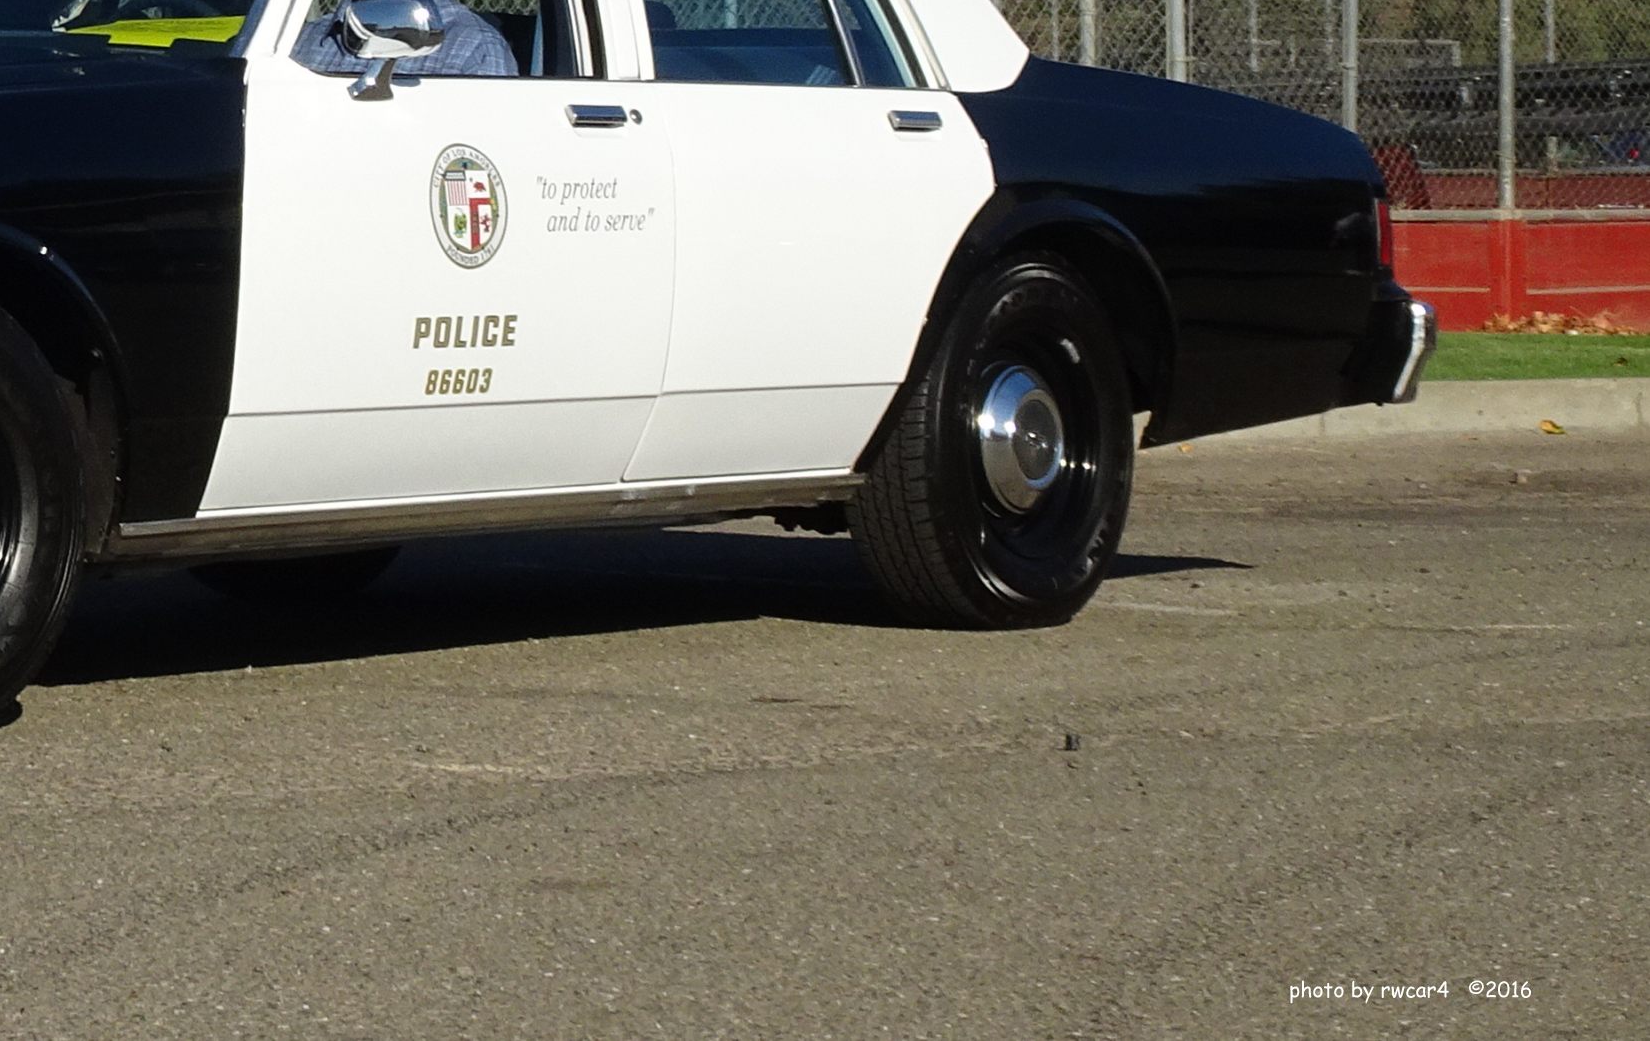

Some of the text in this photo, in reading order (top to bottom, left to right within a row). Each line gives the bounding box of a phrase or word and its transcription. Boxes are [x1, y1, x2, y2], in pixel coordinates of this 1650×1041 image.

[433, 164, 445, 188] CITY
[443, 153, 451, 164] OF
[451, 148, 467, 158] LOS
[561, 177, 617, 206] protect
[546, 207, 655, 233] and to serve"
[413, 314, 518, 349] POLICE
[424, 367, 493, 396] 86603
